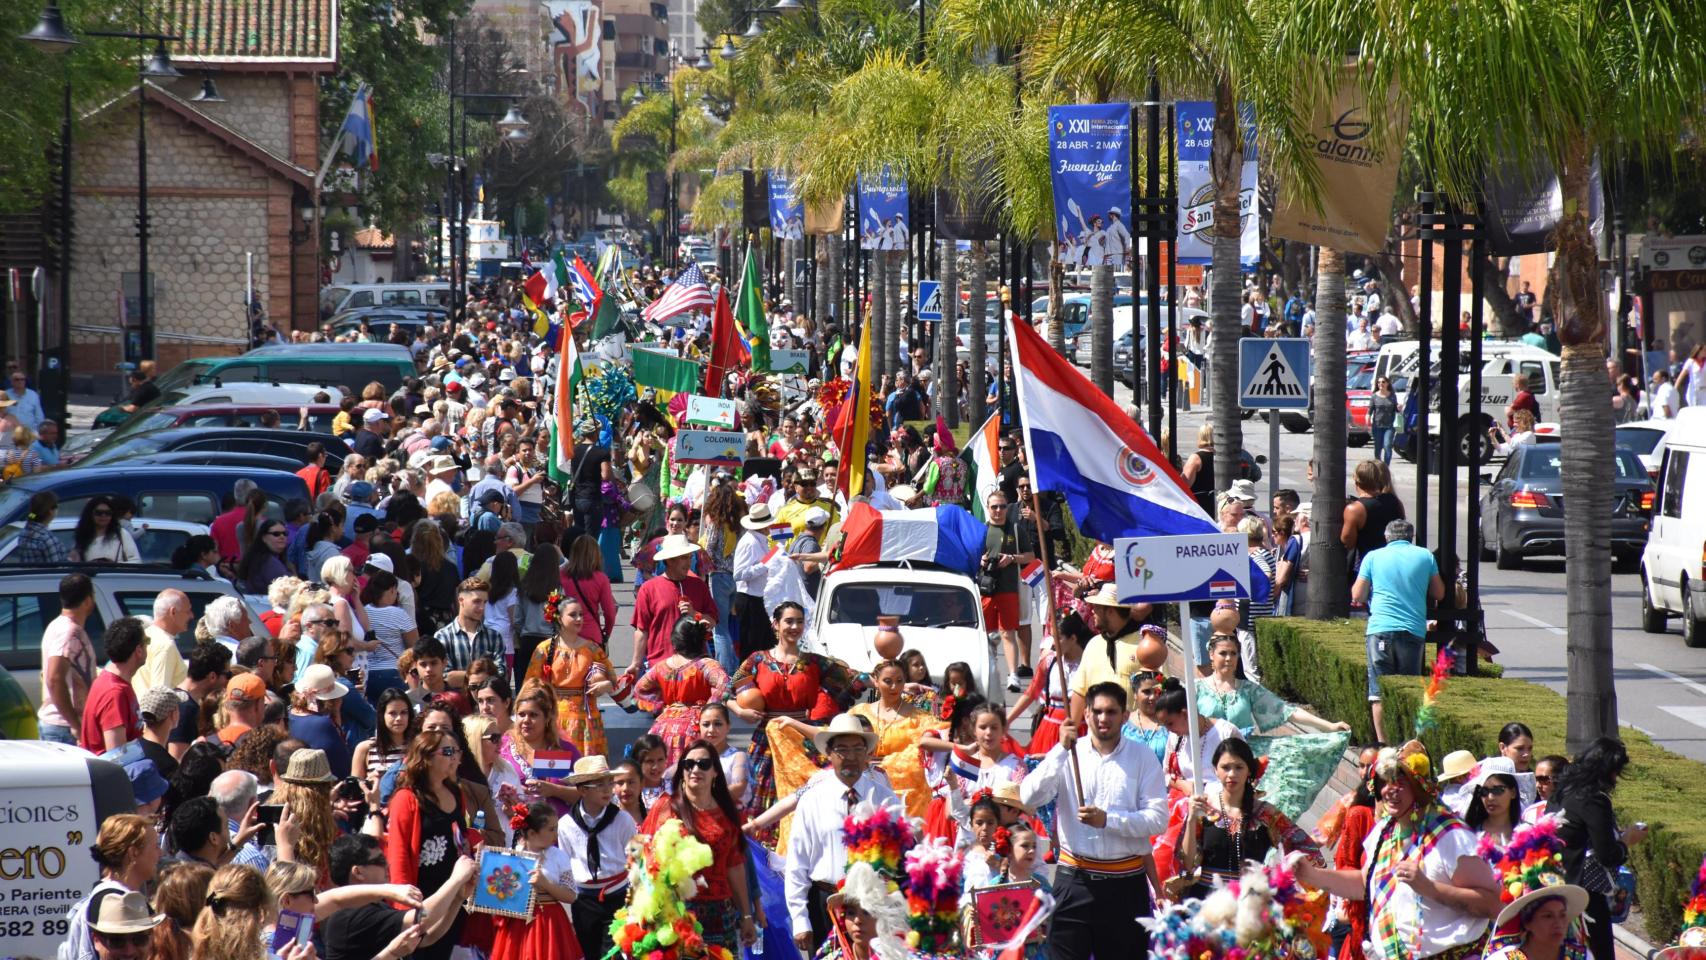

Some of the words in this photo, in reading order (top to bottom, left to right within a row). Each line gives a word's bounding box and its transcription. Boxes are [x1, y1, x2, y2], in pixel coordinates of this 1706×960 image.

[1068, 119, 1090, 133] XXII
[1056, 141, 1067, 149] 28
[1068, 141, 1089, 149] ABR
[1095, 141, 1102, 149] 2
[1103, 141, 1122, 149] MAY
[1184, 139, 1196, 148] 28
[1197, 139, 1213, 148] AB
[1056, 159, 1122, 175] Fuengirola
[1182, 210, 1211, 230] San
[704, 435, 743, 444] COLOMBIA
[1176, 543, 1240, 558] PARAGUAY
[11, 888, 82, 901] Pariente
[33, 904, 70, 916] (Sevill
[42, 919, 69, 936] 89
